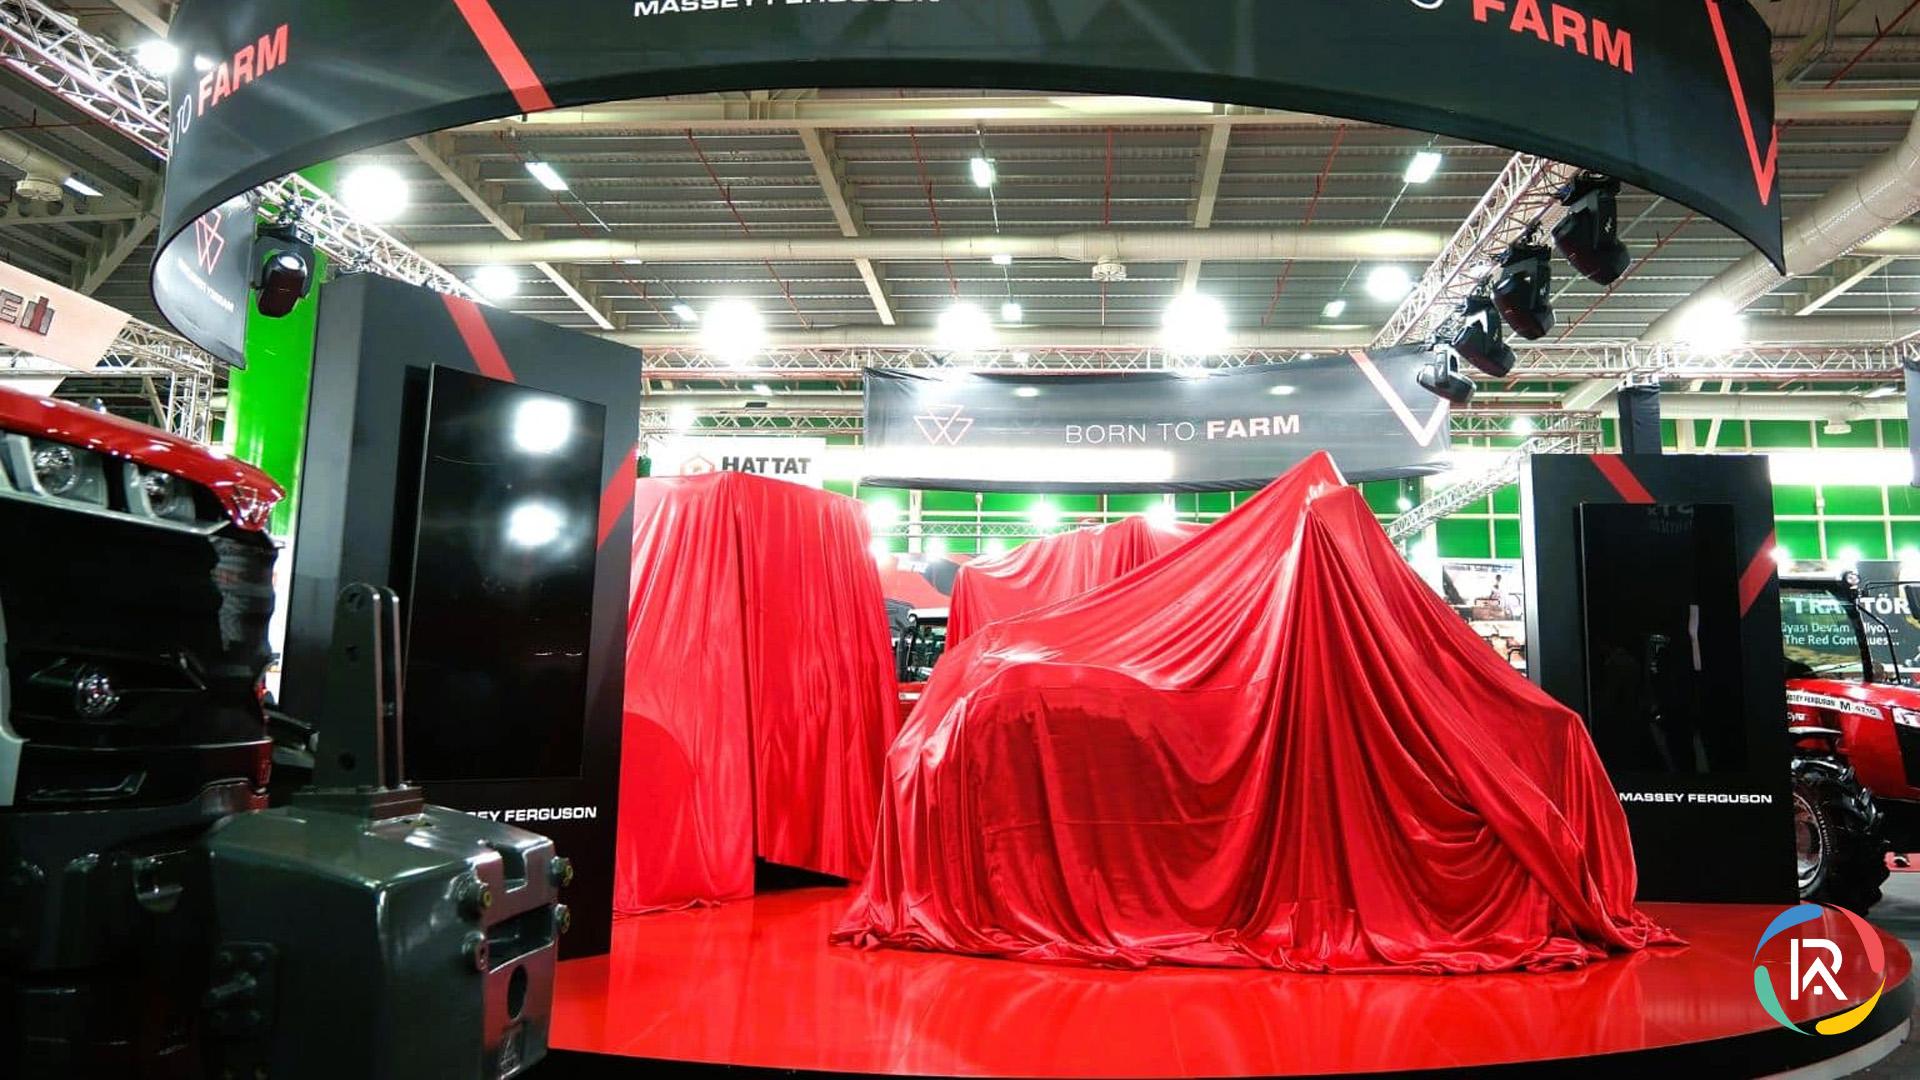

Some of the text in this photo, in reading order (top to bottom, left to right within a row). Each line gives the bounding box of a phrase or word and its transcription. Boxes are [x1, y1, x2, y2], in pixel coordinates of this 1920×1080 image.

[198, 23, 289, 117] FARM
[1065, 414, 1300, 444] BORN TO FARM
[1808, 635, 1830, 645] Red
[1619, 792, 1772, 803] MASSEY FERGUSON
[504, 806, 597, 823] FERGUSON
